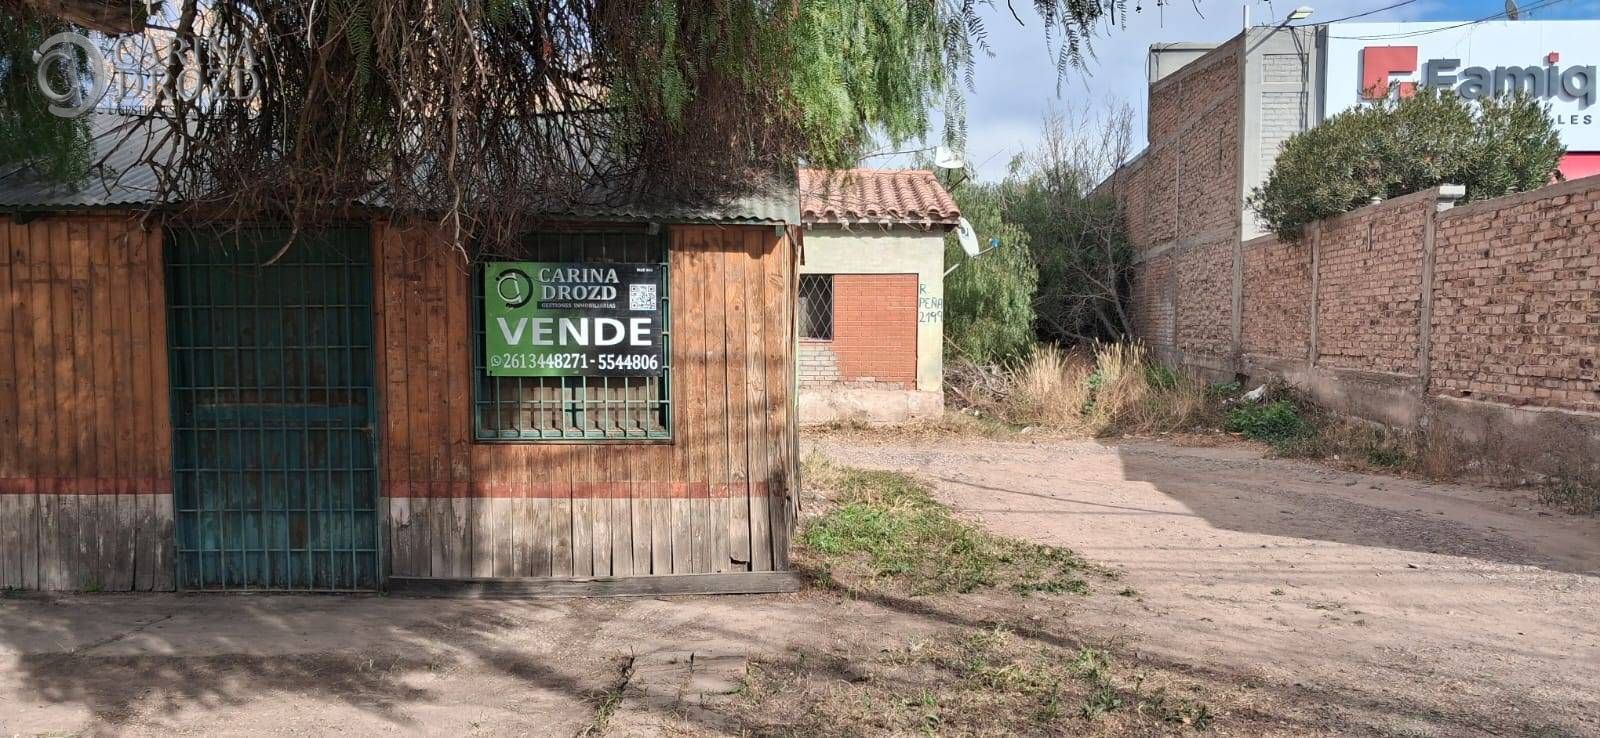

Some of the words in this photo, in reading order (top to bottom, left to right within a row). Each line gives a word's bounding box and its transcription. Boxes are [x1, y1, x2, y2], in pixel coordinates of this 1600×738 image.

[1427, 52, 1597, 107] Famiq
[539, 267, 620, 284] CARINA
[541, 285, 618, 301] DROZD
[919, 283, 927, 295] R
[496, 317, 653, 346] VENDE
[598, 354, 658, 369] 5544806
